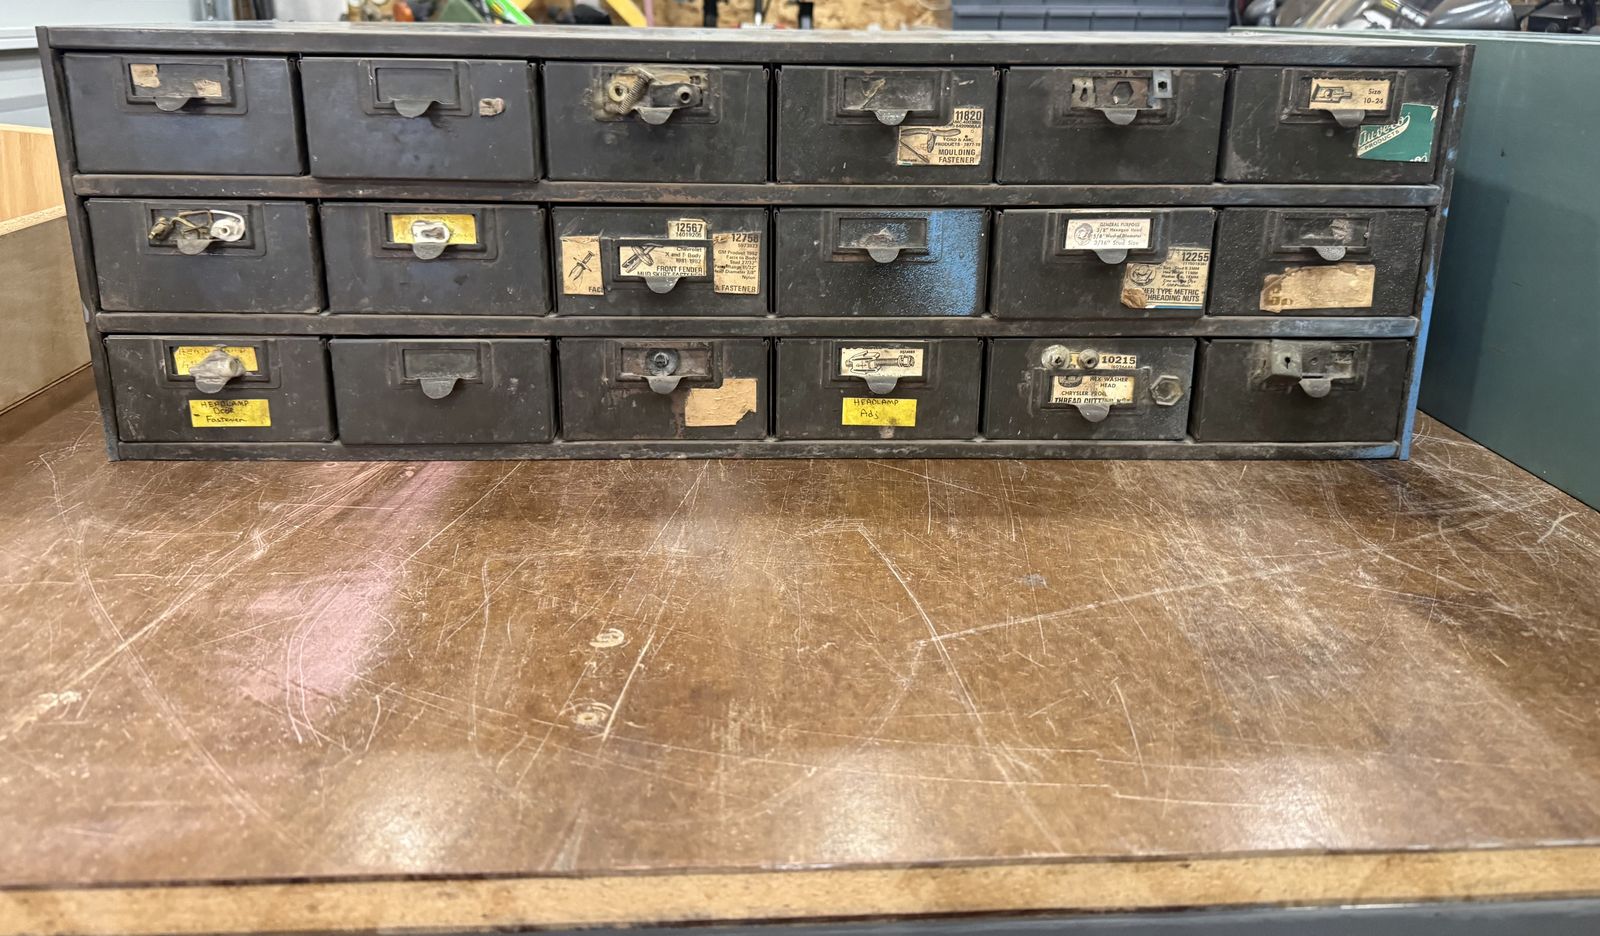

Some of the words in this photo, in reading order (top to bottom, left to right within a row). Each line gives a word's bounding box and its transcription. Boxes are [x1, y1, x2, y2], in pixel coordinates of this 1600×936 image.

[955, 110, 982, 121] 11820
[1364, 129, 1400, 151] PRODUCTS
[675, 222, 704, 233] 12567
[732, 232, 759, 243] 12758
[1181, 251, 1210, 262] 12255
[678, 265, 703, 273] FENDER
[720, 284, 757, 293] FASTENER
[1101, 355, 1136, 365] 10215
[860, 408, 880, 420] Adj
